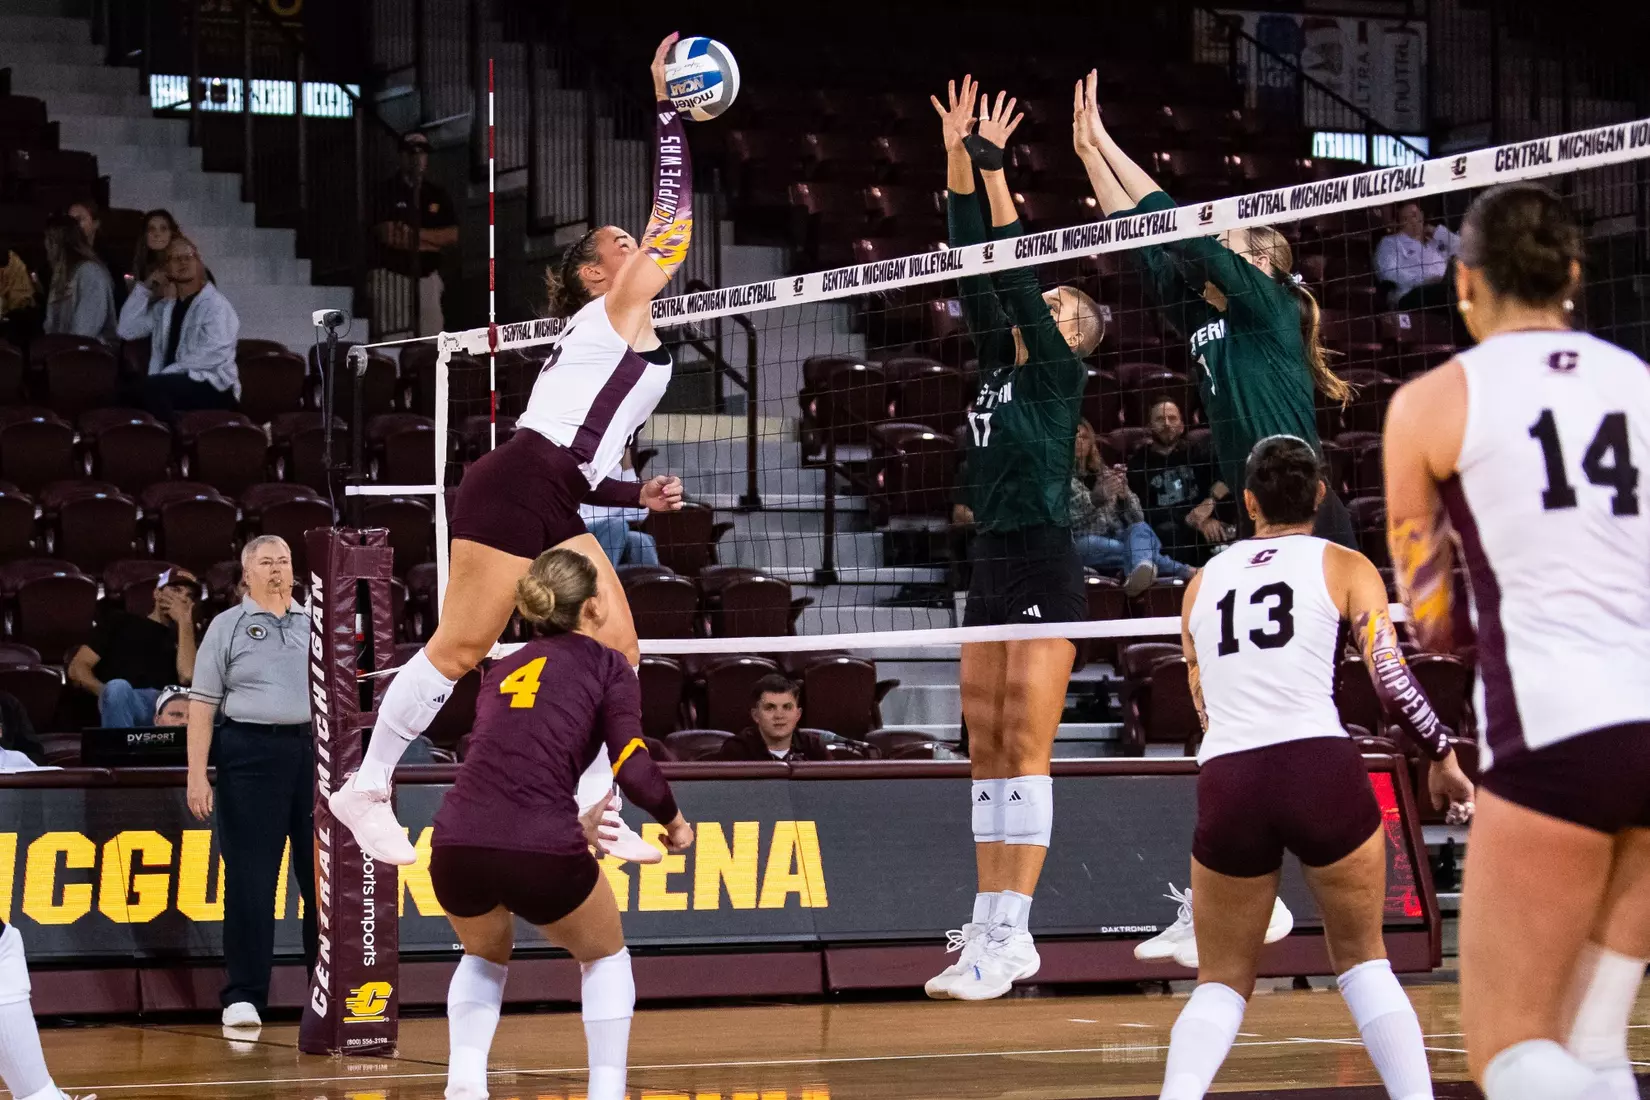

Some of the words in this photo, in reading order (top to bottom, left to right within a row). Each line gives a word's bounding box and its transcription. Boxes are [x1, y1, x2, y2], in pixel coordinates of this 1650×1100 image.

[670, 75, 705, 96] NCAA
[673, 90, 714, 108] molten
[1495, 140, 1552, 173] CENTRAL
[1557, 127, 1625, 163] MICHIGAN
[654, 136, 682, 224] CHIPPEWAS
[1237, 186, 1287, 220] CENTRAL
[1290, 179, 1348, 210] MICHIGAN
[1352, 164, 1425, 200] VOLLEYBALL
[1015, 233, 1058, 260] CENTRAL
[1062, 223, 1112, 252] MICHIGAN
[1115, 212, 1178, 242] VOLLEYBALL
[821, 266, 860, 293] CENTRAL
[862, 259, 906, 285] MICHIGAN
[909, 250, 963, 278] VOLLEYBALL
[651, 299, 685, 319] CENTRAL
[687, 291, 727, 313] MICHIGAN
[728, 282, 777, 309] VOLLEYBALL
[502, 322, 532, 343] CENTRAL
[967, 412, 993, 448] 17
[1528, 408, 1640, 516] 14
[1216, 581, 1295, 657] 13
[310, 571, 333, 801] MICHIGAN
[500, 656, 548, 708] 4
[1371, 647, 1441, 739] CHIPPEWAS
[360, 848, 377, 895] ports
[311, 827, 332, 1018] CENTRAL
[360, 897, 377, 967] imports
[1101, 925, 1157, 933] DAKTRONICS
